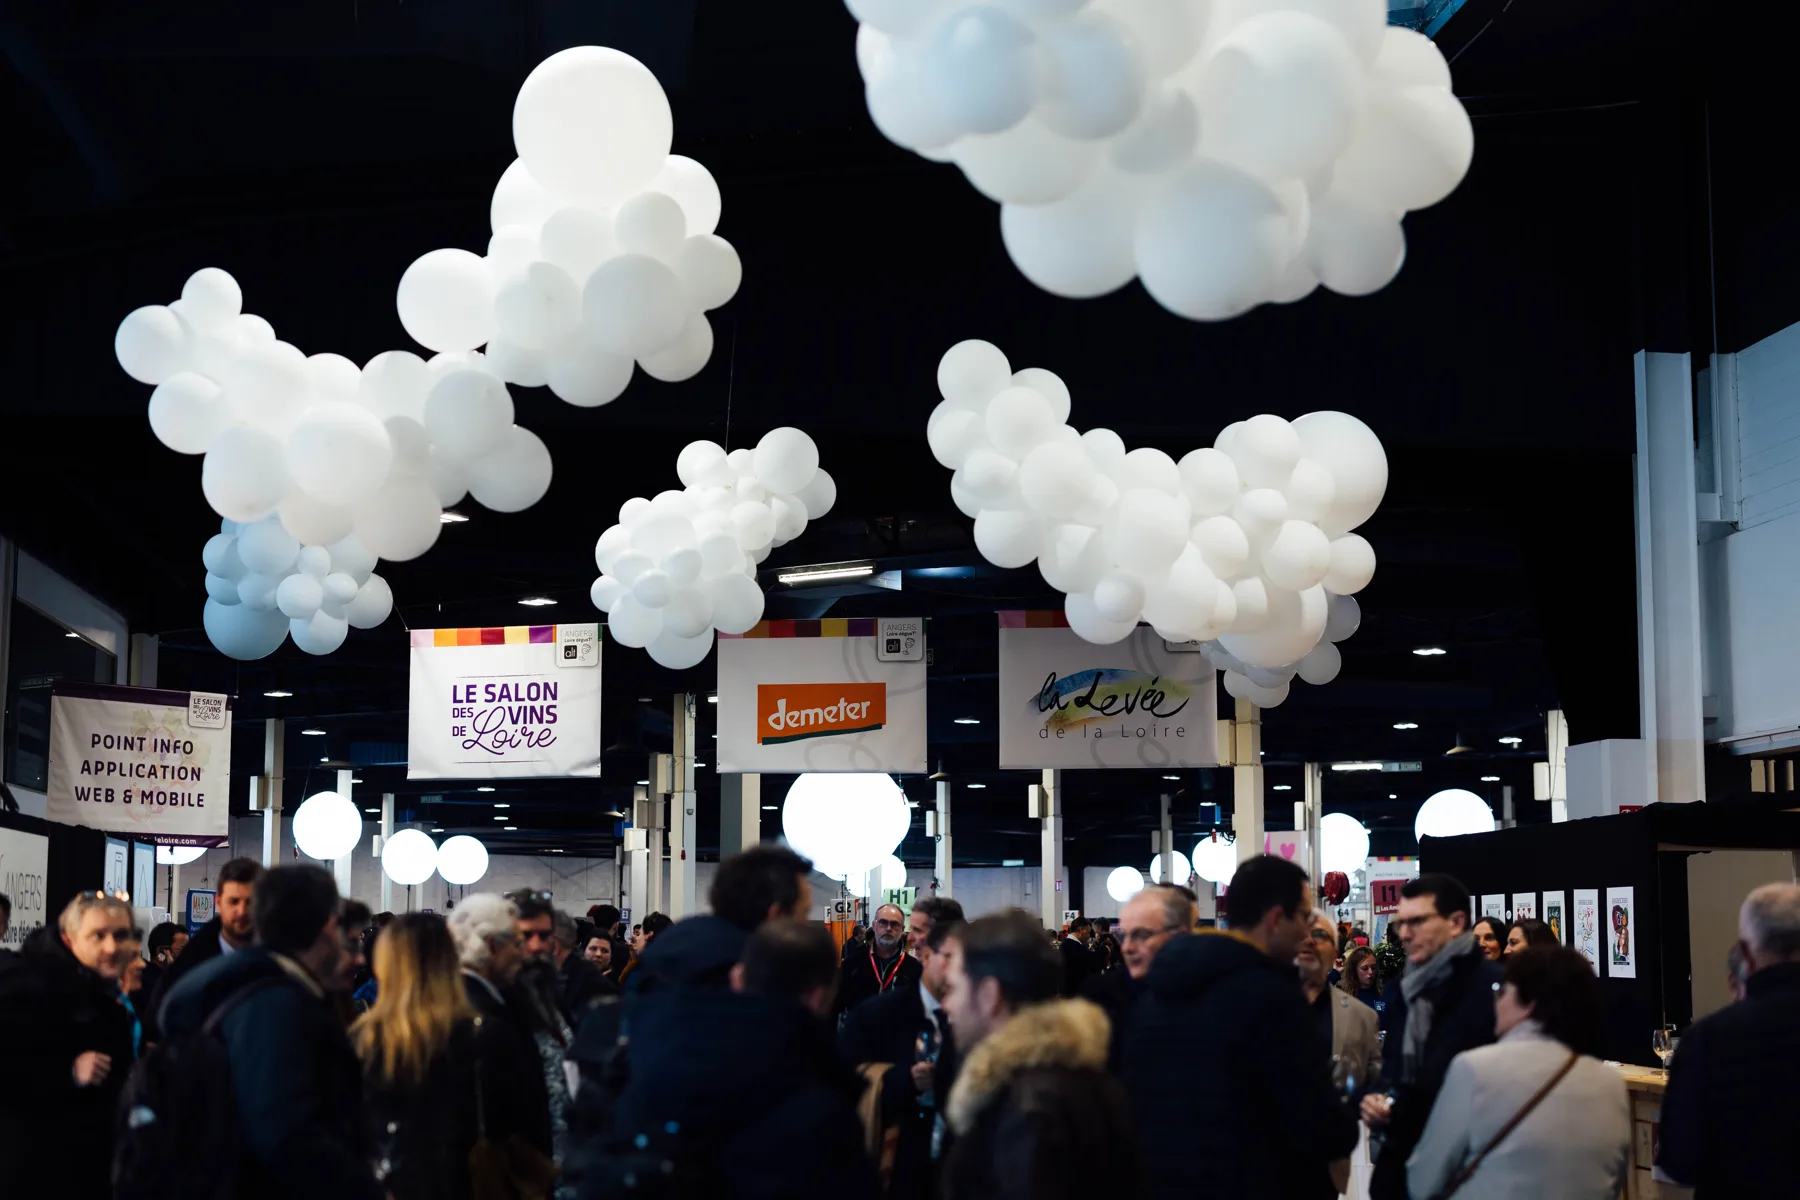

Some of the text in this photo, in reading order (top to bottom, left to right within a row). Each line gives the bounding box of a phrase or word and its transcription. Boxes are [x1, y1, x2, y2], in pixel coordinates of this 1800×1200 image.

[564, 629, 593, 638] ANGERS
[887, 623, 917, 631] ANGERS
[202, 698, 222, 706] SALON
[452, 681, 558, 704] LE SALON
[1038, 671, 1190, 718] la Levée
[452, 704, 558, 726] DES VINS
[767, 696, 871, 731] demeter
[452, 705, 558, 756] DE Loire
[1039, 724, 1186, 739] de la Loire
[91, 733, 194, 755] POINT INFO
[80, 760, 202, 782] APPLICATION
[74, 785, 205, 808] WEB & MOBILE
[4, 872, 42, 911] ANGERS
[890, 889, 908, 905] H1
[834, 901, 852, 914] G2
[1064, 911, 1076, 921] F4
